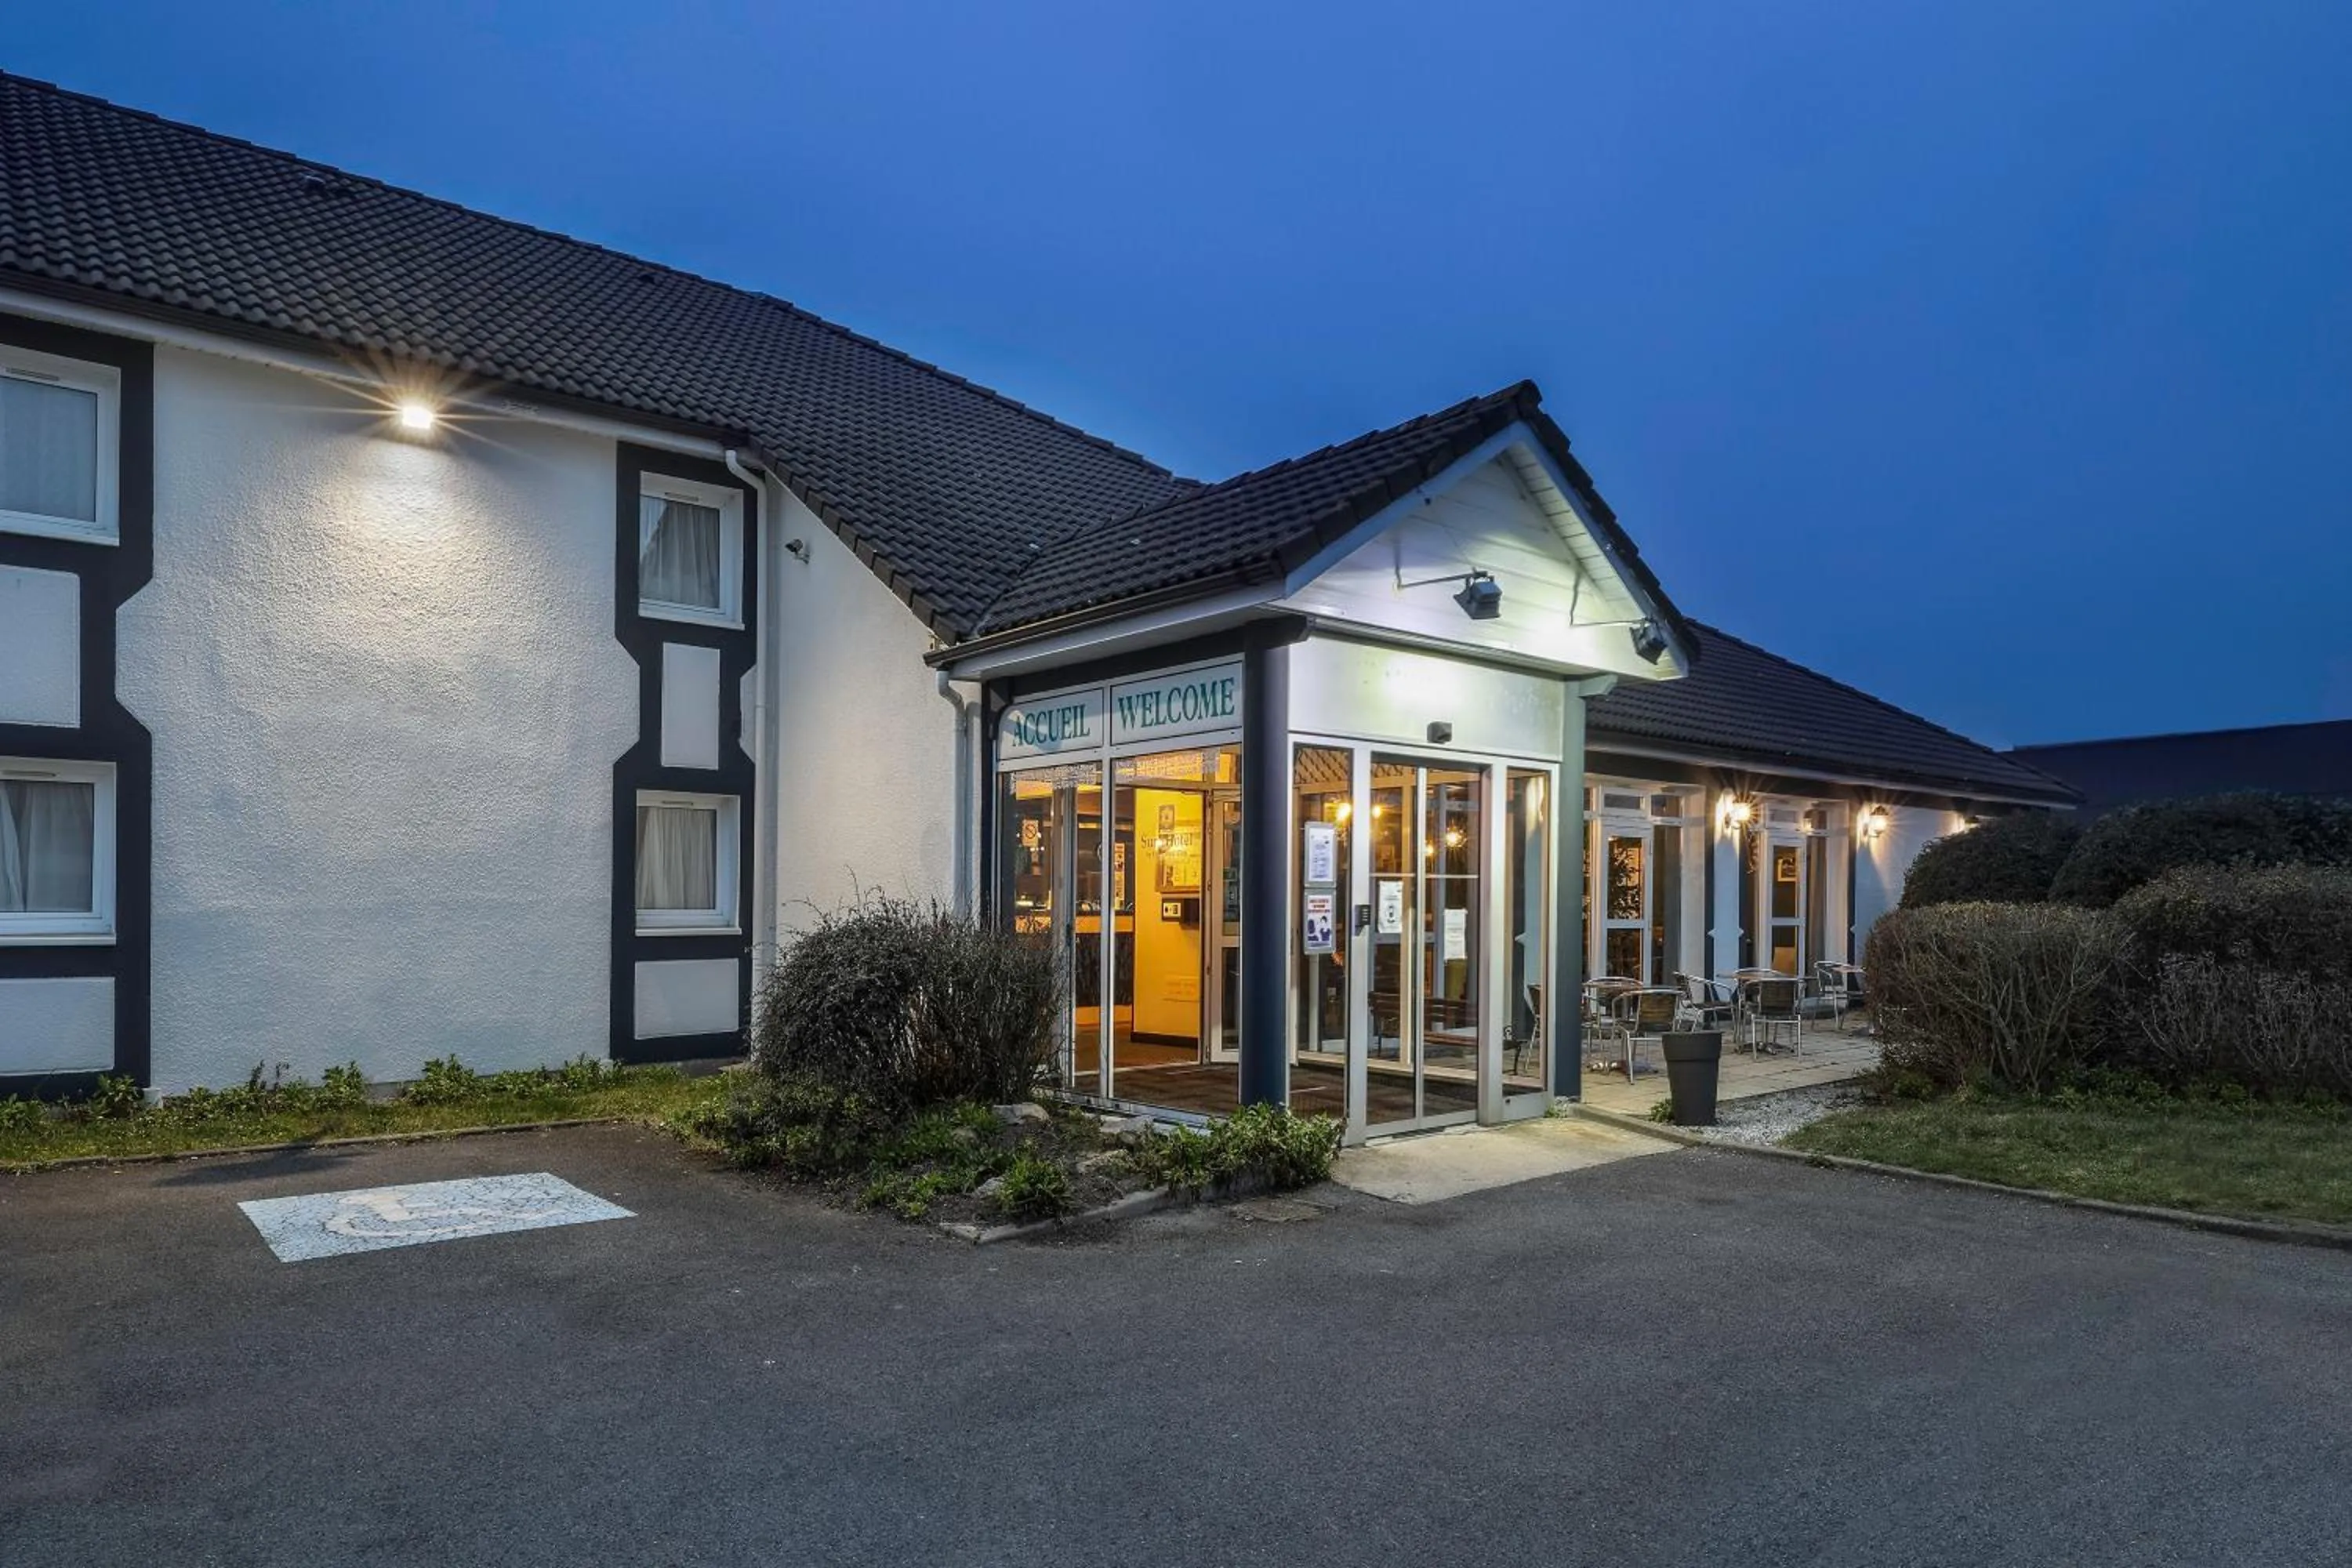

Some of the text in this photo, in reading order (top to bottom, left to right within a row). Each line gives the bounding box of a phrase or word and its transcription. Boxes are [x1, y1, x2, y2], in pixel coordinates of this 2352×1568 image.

[1119, 678, 1235, 730] WELCOME
[1012, 705, 1091, 746] ACCUEIL
[1141, 836, 1163, 848] Sur
